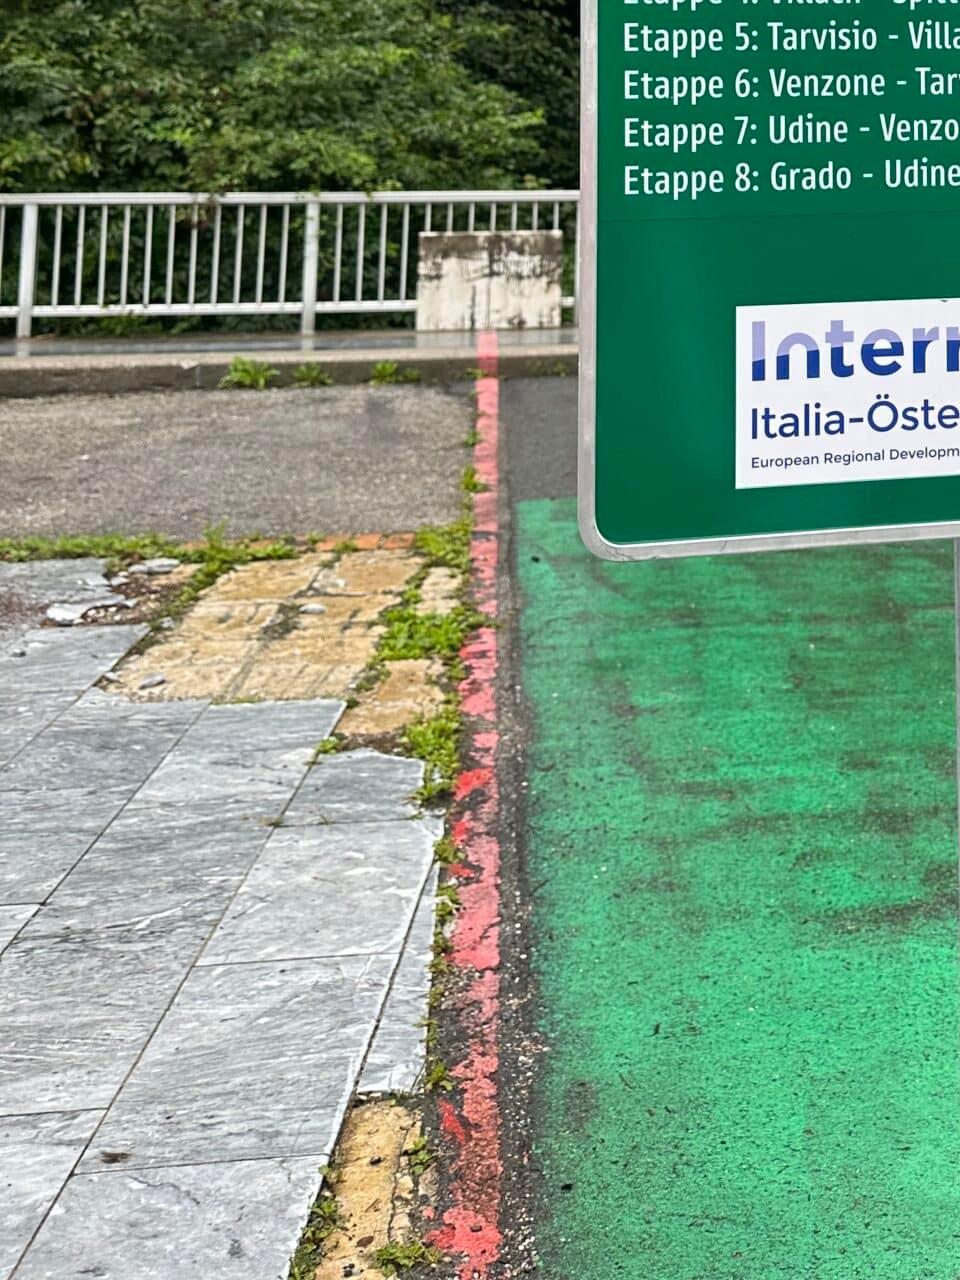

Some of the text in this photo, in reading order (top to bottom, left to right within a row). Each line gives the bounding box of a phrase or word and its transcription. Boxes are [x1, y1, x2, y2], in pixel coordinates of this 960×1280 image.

[625, 23, 722, 57] Etappe
[736, 23, 757, 50] 5:
[768, 21, 876, 50] Tarvisio
[625, 71, 723, 105] Etappe
[736, 69, 758, 97] 6:
[769, 69, 884, 96] Venzone
[625, 118, 723, 152] Etappe
[735, 116, 756, 144] 7:
[770, 113, 847, 143] Udine
[625, 166, 723, 200] Etappe
[735, 163, 758, 191] 8:
[771, 161, 851, 190] Grado
[886, 158, 960, 187] Udine
[752, 456, 819, 469] European
[824, 449, 884, 465] Regional
